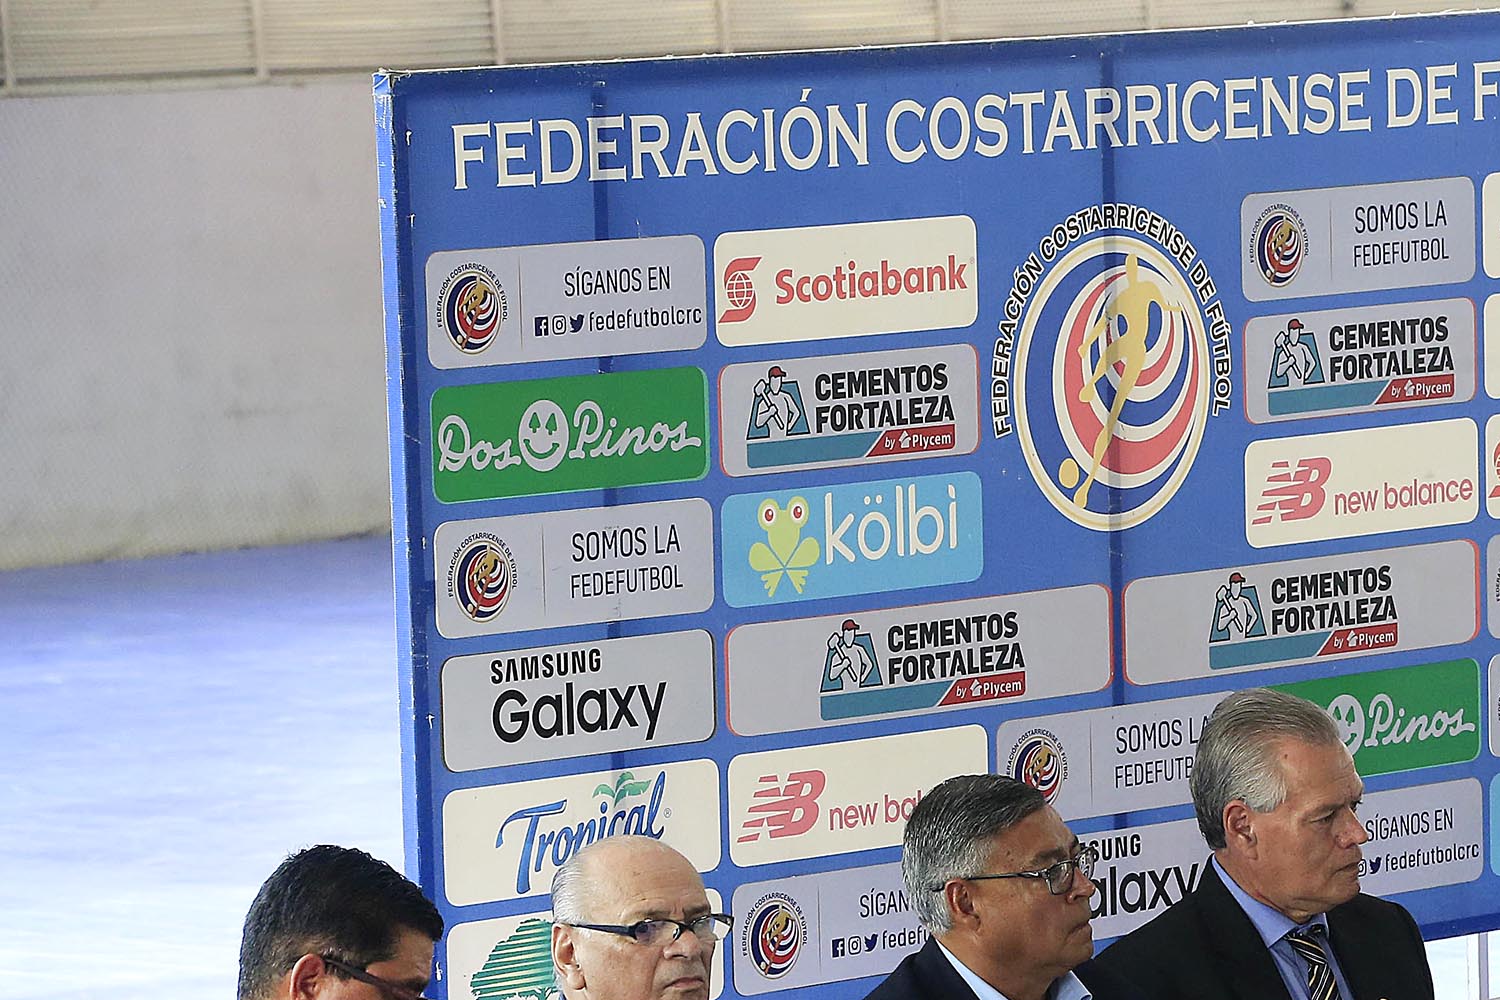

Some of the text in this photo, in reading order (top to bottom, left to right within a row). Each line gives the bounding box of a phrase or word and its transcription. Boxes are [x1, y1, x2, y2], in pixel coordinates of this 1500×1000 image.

[452, 87, 869, 190] FEDERACIÓN
[885, 69, 1372, 164] COSTARRICENSE
[1386, 63, 1459, 126] DE
[1354, 199, 1447, 234] SOMOS LA
[1353, 237, 1450, 268] FEDEFUTBOL
[564, 266, 671, 297] SÍGANOS EN
[775, 255, 967, 304] Scotiabank
[589, 305, 702, 332] fedefutbolcrc
[992, 204, 1232, 438] FEDERACIÓN COSTARRICENSE DE FÚTBOL
[1329, 316, 1449, 351] CEMENTOS
[815, 363, 948, 401] CEMENTOS
[1330, 346, 1454, 382] FORTALEZA
[1391, 381, 1451, 398] by Plycem
[816, 395, 955, 434] FORTALEZA
[438, 400, 702, 472] Dos Pinos
[884, 432, 952, 450] by Plycem
[1334, 478, 1474, 516] new balance
[825, 483, 958, 565] kölbi
[571, 524, 681, 562] SOMOS LA
[571, 564, 683, 599] FEDEFUTBOL
[1271, 565, 1392, 604] CEMENTOS
[888, 611, 1018, 652] CEMENTOS
[1272, 595, 1398, 635] FORTALEZA
[1333, 630, 1395, 649] by Plycem
[490, 648, 601, 684] SAMSUNG
[888, 643, 1025, 685] FORTALEZA
[956, 679, 1022, 699] by Plycem
[492, 681, 667, 743] Galaxy
[1364, 693, 1475, 748] Pinos
[1116, 719, 1183, 755] SOMOS
[1006, 741, 1019, 775] ERACIÓN
[1115, 756, 1194, 789] FEDEFUTB
[829, 802, 879, 831] new
[1365, 807, 1454, 842] SÍGANOS EN
[1081, 834, 1141, 862] SUNG
[1385, 842, 1480, 873] fedefutbolcrc
[859, 887, 910, 918] SÍGAN
[1090, 863, 1200, 919] alaxy
